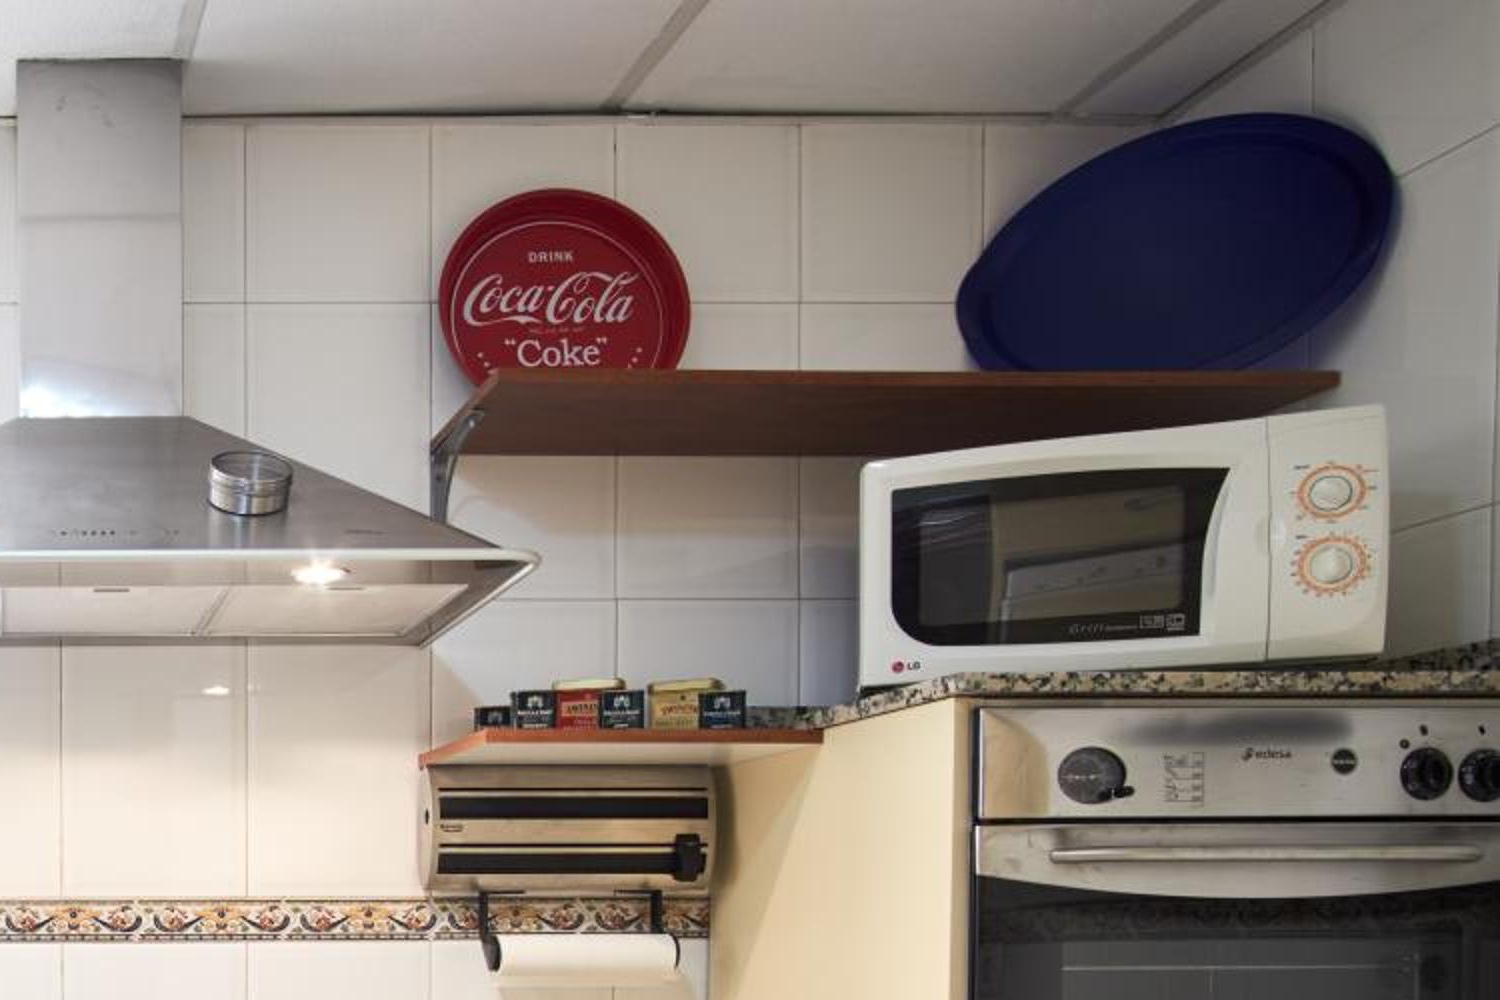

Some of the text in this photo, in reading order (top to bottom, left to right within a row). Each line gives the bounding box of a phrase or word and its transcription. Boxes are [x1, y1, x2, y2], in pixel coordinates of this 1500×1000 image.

[528, 252, 573, 263] DRINK
[463, 271, 639, 326] Coca-Cola
[907, 661, 921, 671] LG
